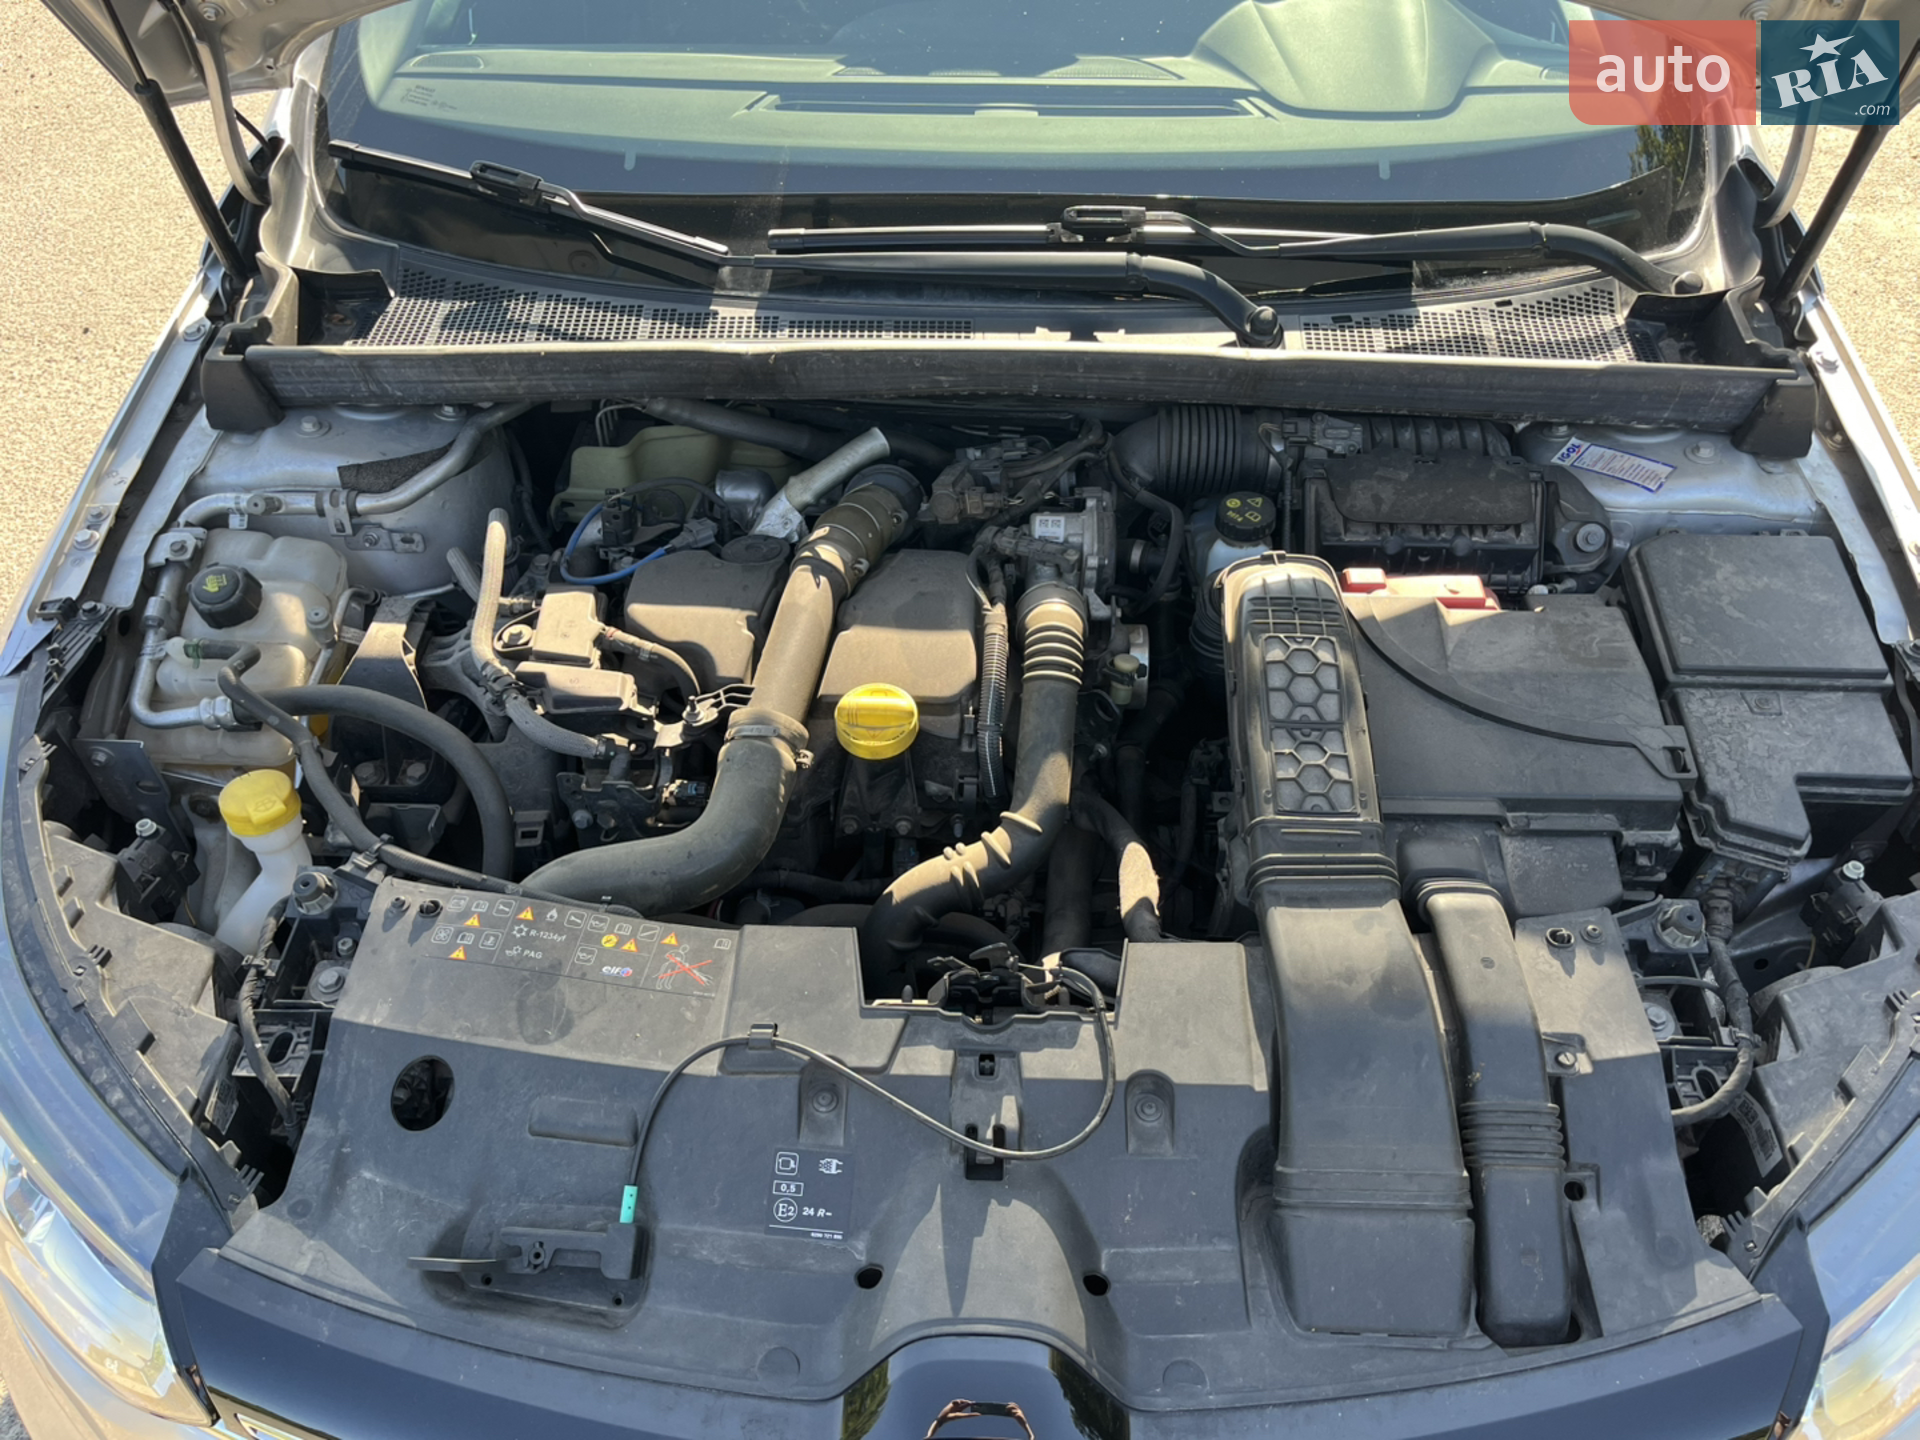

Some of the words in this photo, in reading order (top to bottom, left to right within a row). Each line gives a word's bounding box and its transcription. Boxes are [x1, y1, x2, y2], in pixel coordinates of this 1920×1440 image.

[1557, 443, 1581, 462] IGOL
[529, 929, 567, 942] R-1234yf
[523, 949, 543, 959] PAG
[780, 1183, 796, 1193] 0,5
[802, 1207, 815, 1216] 24
